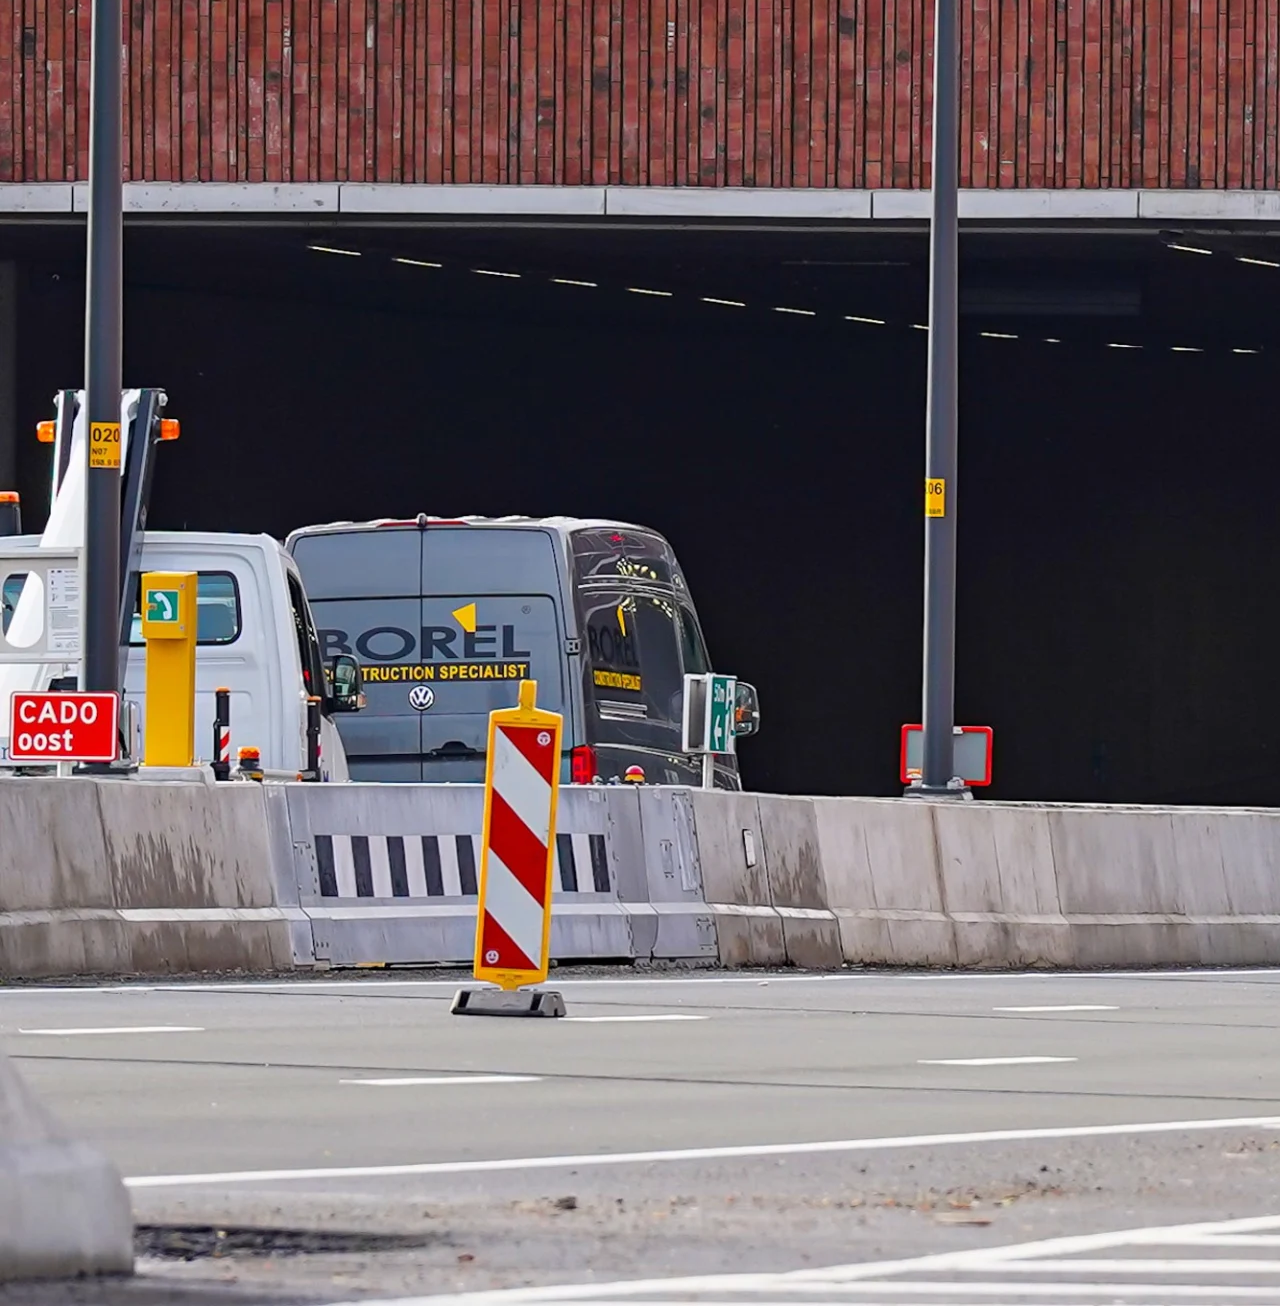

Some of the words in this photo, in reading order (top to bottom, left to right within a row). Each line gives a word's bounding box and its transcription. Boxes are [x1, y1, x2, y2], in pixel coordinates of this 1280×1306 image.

[317, 625, 531, 662] BOREL
[440, 664, 527, 679] SPECIALIST
[19, 700, 98, 724] CADO
[18, 729, 74, 751] oost
